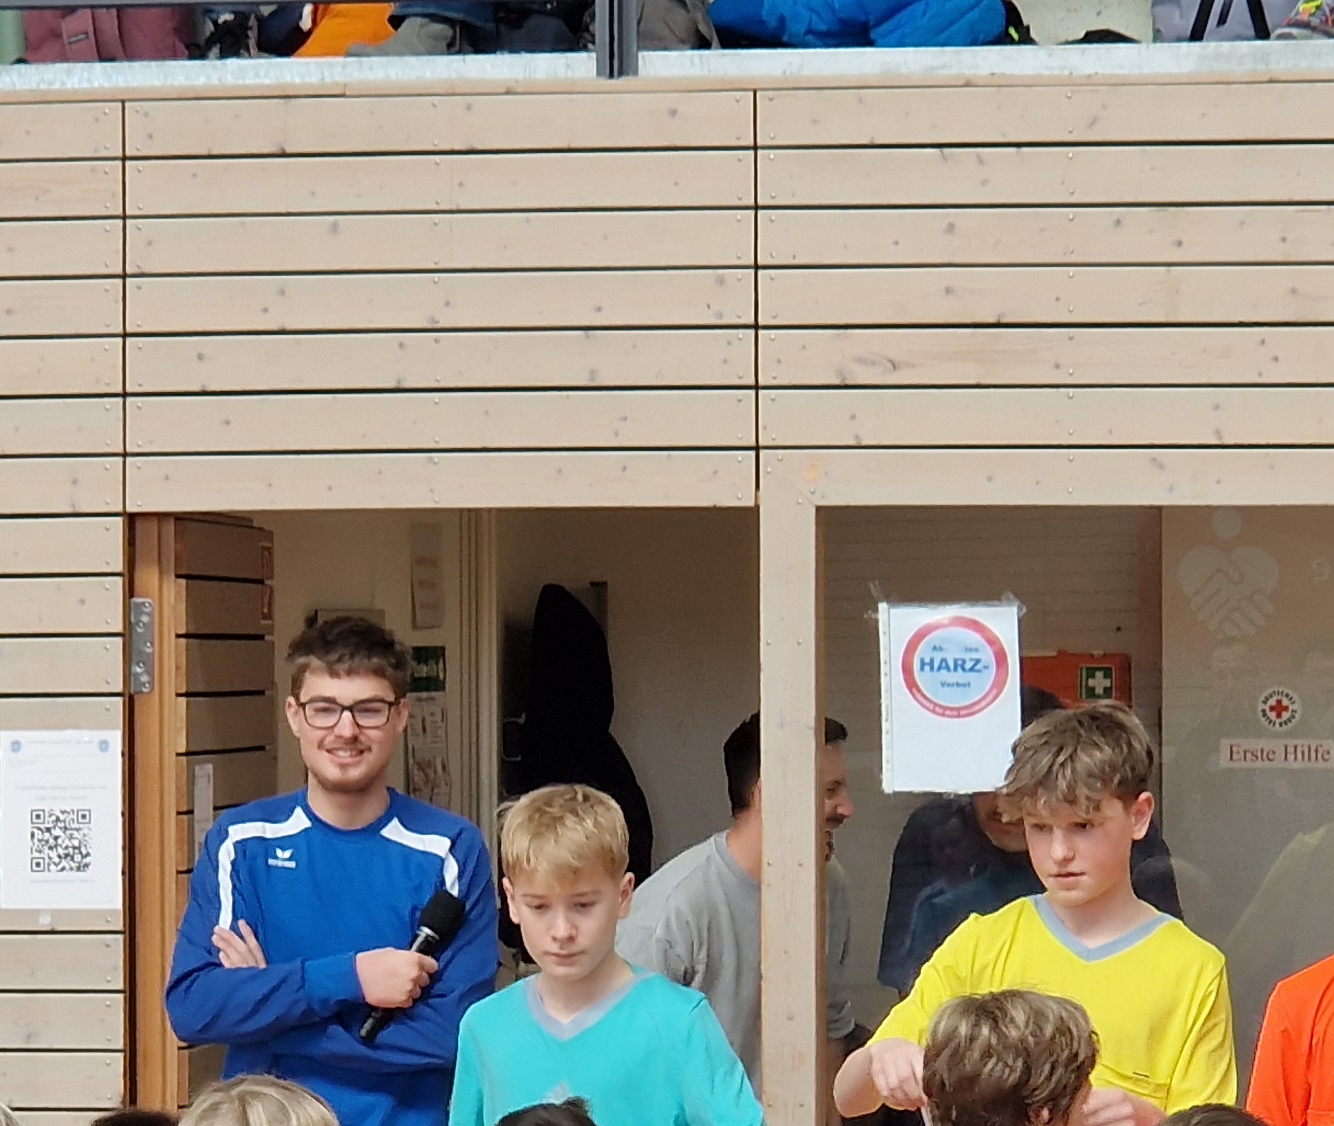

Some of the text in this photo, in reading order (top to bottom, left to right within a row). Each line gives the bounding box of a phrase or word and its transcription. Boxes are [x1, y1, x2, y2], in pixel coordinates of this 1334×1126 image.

[919, 657, 989, 673] HARZ-
[940, 680, 971, 689] Verbot
[1229, 743, 1331, 762] Erste Hilfe
